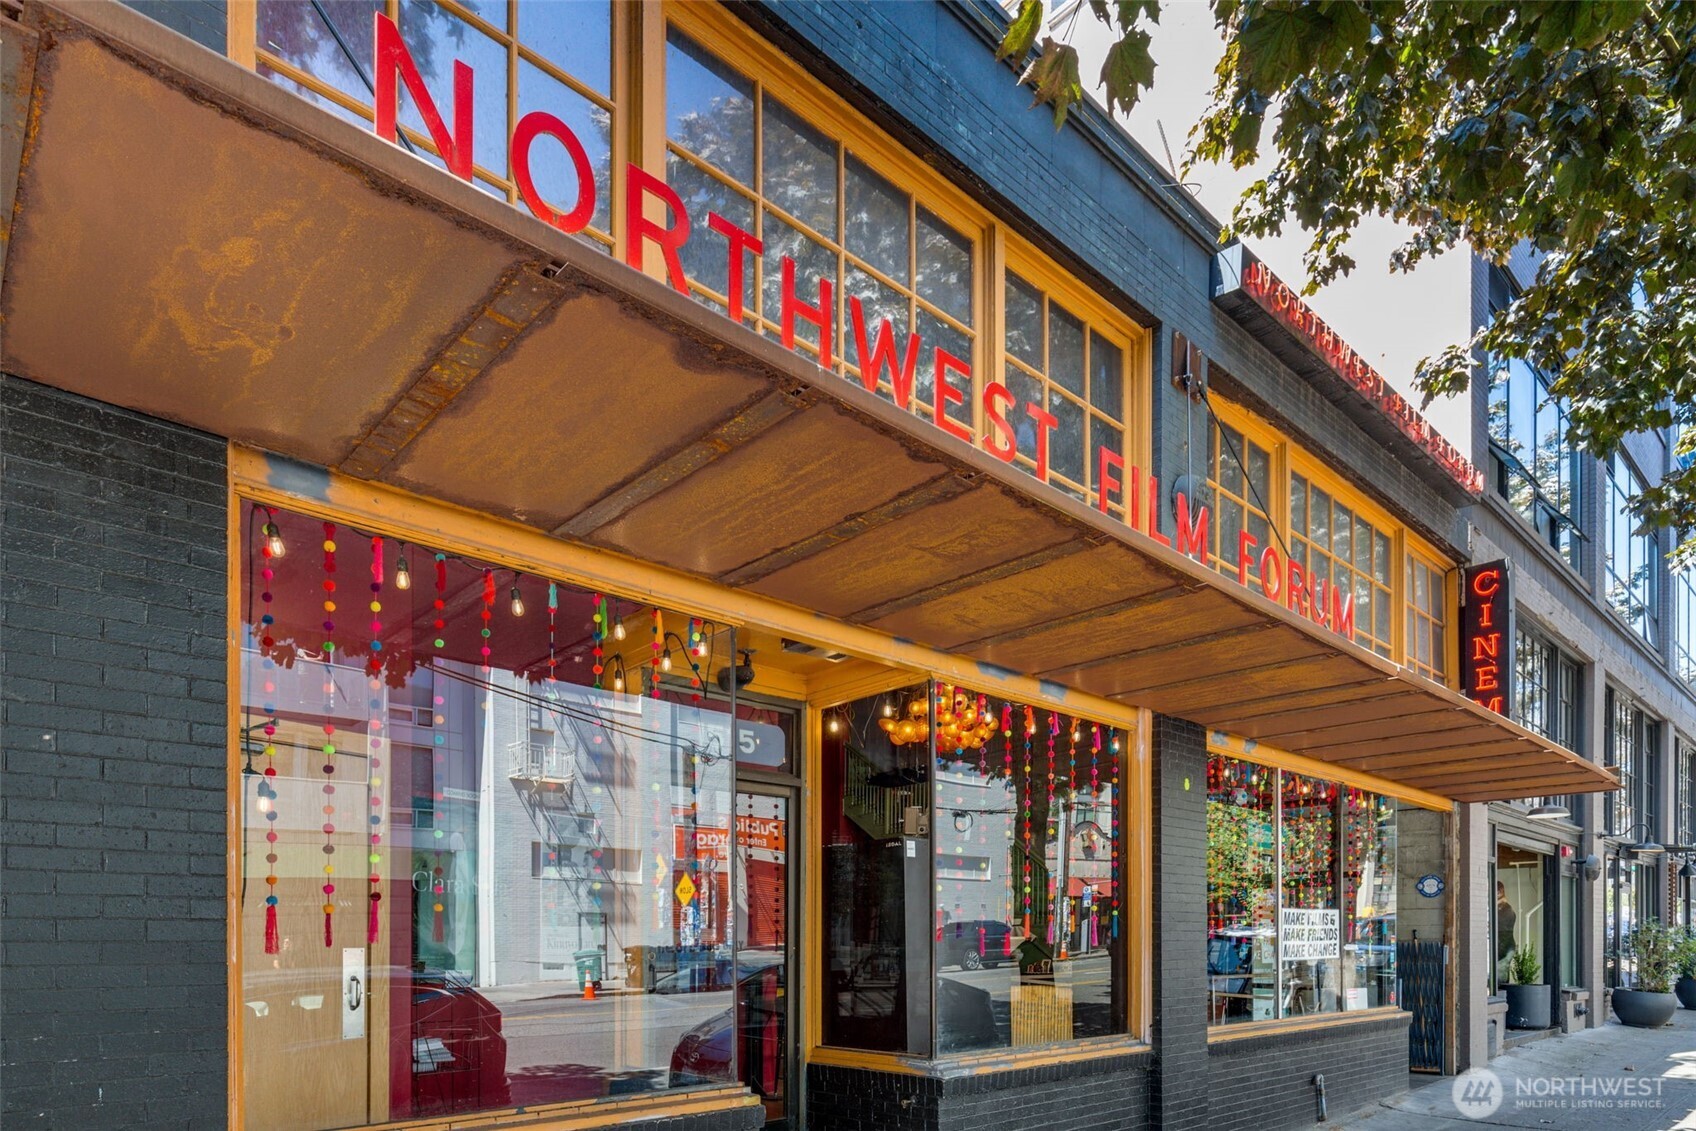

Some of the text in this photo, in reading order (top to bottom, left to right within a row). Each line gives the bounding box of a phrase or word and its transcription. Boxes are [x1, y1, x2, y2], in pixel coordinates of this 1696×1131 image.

[374, 11, 1355, 641] NORTHWEST FILM FORUM
[1252, 261, 1385, 398] NORTHWEST
[1284, 911, 1305, 926] MAKE
[1284, 928, 1338, 942] MAKE FRIENDS
[1284, 944, 1305, 958] MAKE
[1308, 943, 1337, 957] CHANGE
